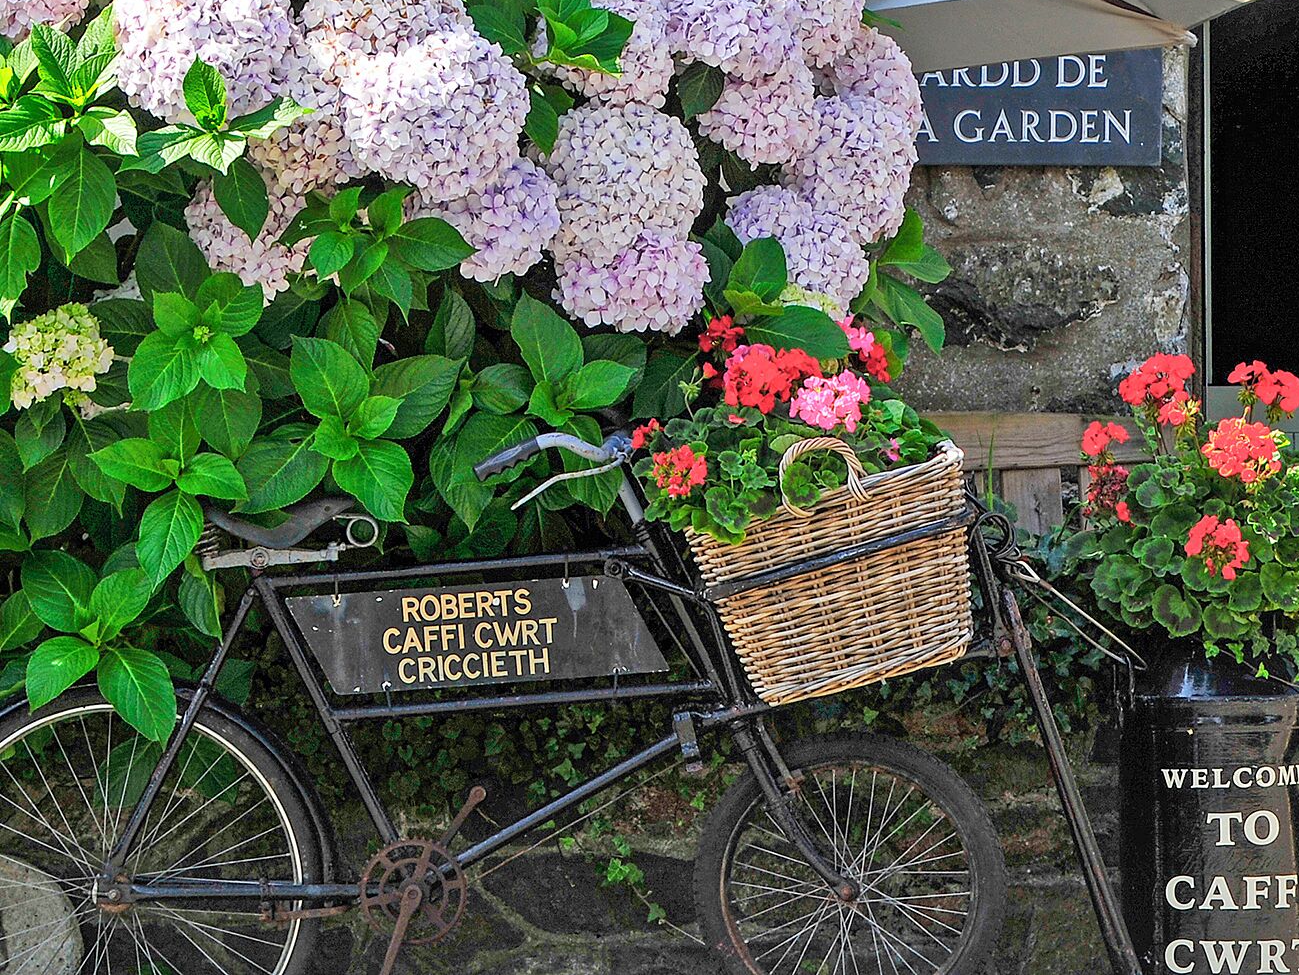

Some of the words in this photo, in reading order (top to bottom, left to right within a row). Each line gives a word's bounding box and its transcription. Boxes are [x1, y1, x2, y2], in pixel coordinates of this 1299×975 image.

[1056, 54, 1108, 88] DE
[953, 109, 1132, 144] GARDEN
[401, 588, 532, 623] ROBERTS
[382, 624, 466, 655] CAFFI
[474, 618, 558, 648] CWRT
[398, 648, 550, 685] CRICCIETH
[1206, 809, 1280, 846] TO
